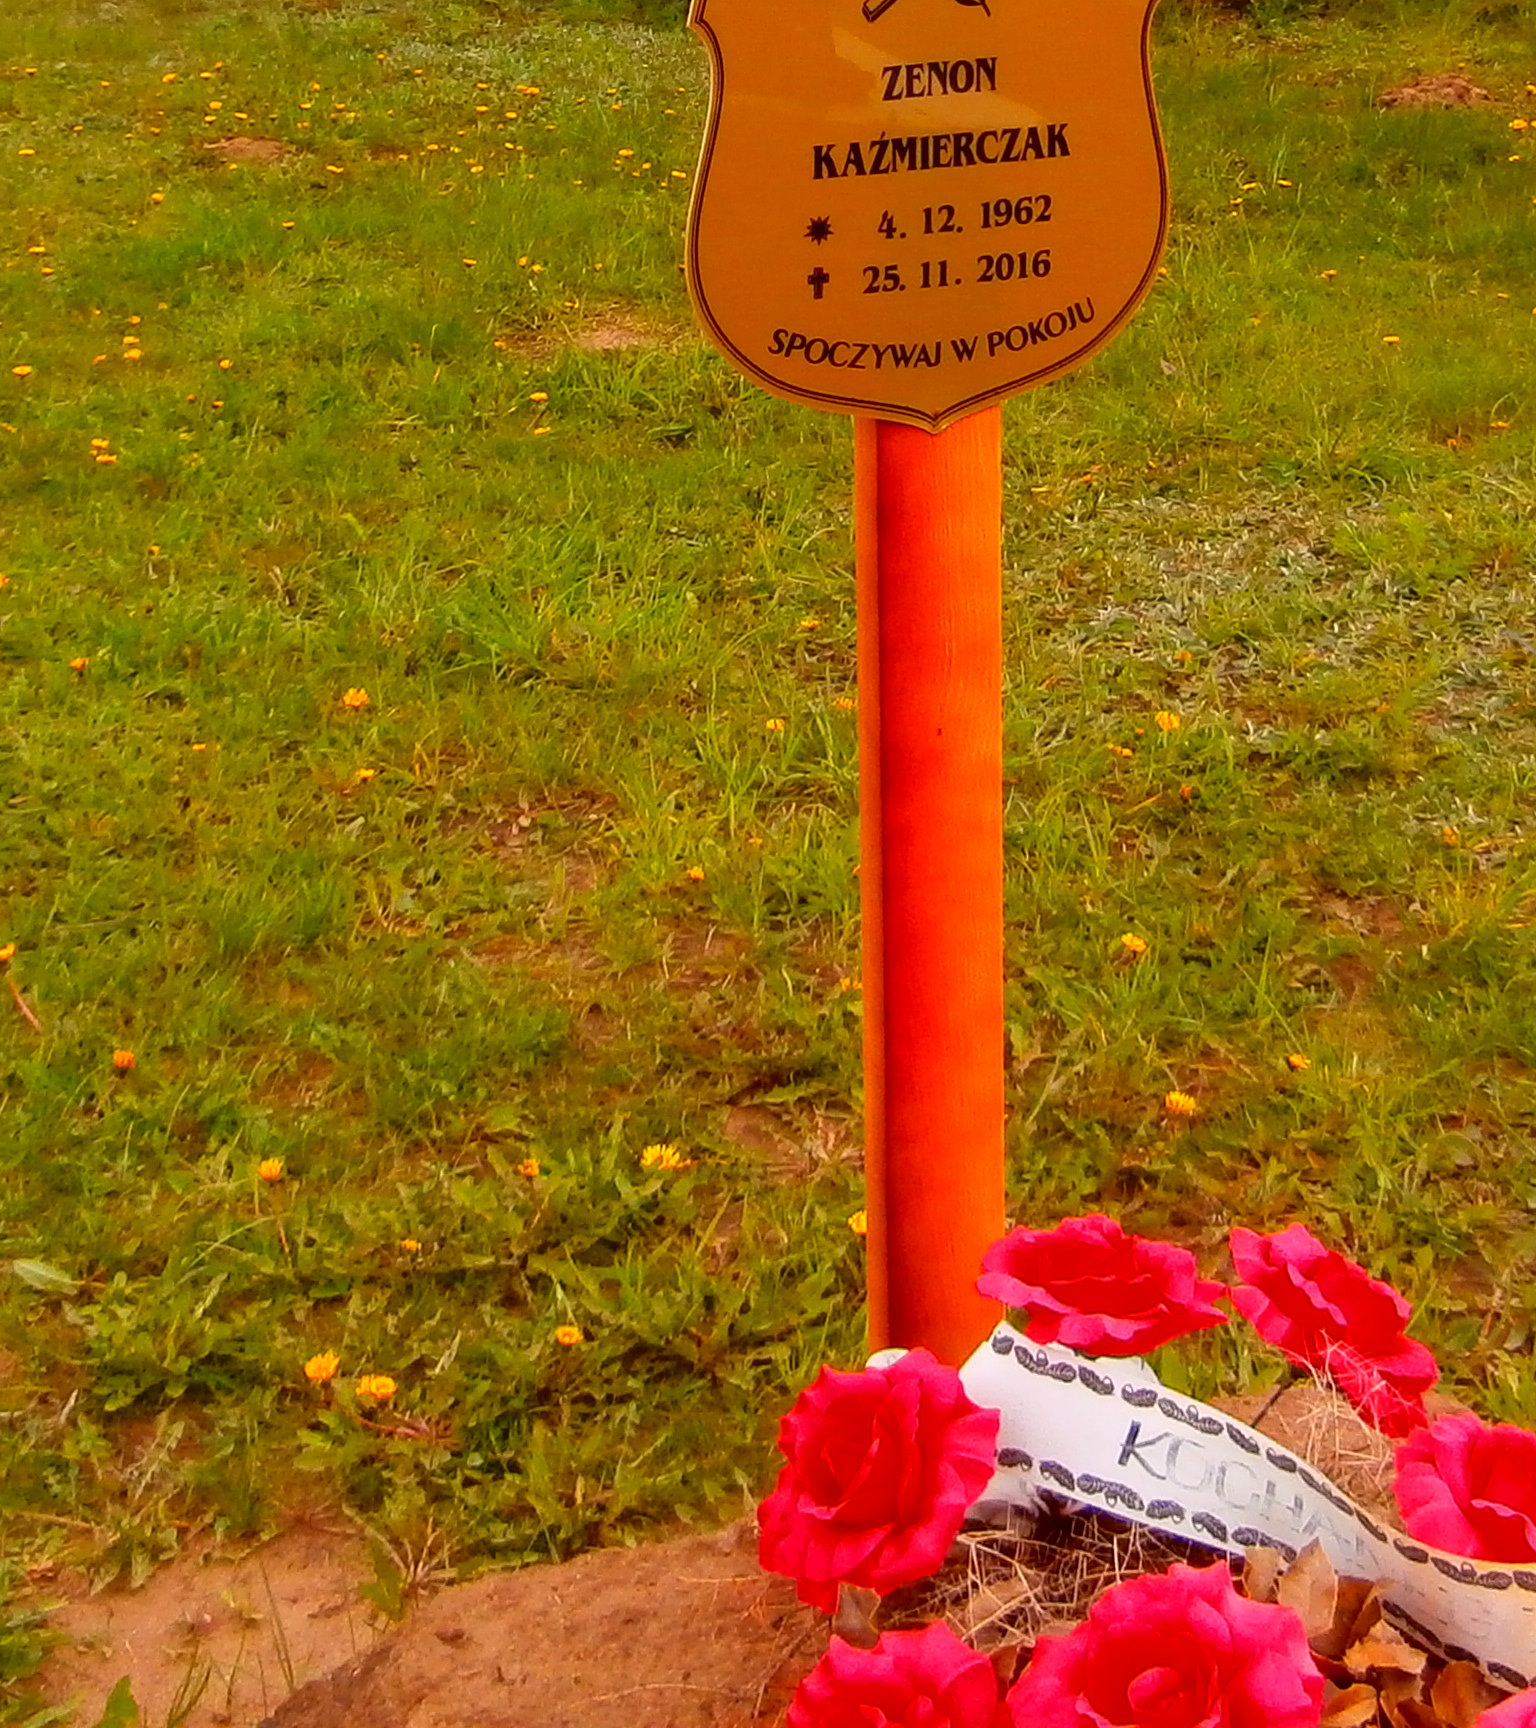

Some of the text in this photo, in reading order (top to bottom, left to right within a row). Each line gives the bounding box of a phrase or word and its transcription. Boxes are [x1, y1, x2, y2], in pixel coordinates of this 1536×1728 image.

[880, 56, 999, 102] ZENON
[812, 122, 1072, 180] KAŹMIERCZAK
[877, 193, 1053, 240] 4. 12. 1962
[861, 248, 1052, 295] 25. 11. 2016
[766, 295, 1096, 370] SPOCZYWAJ W POKOJU
